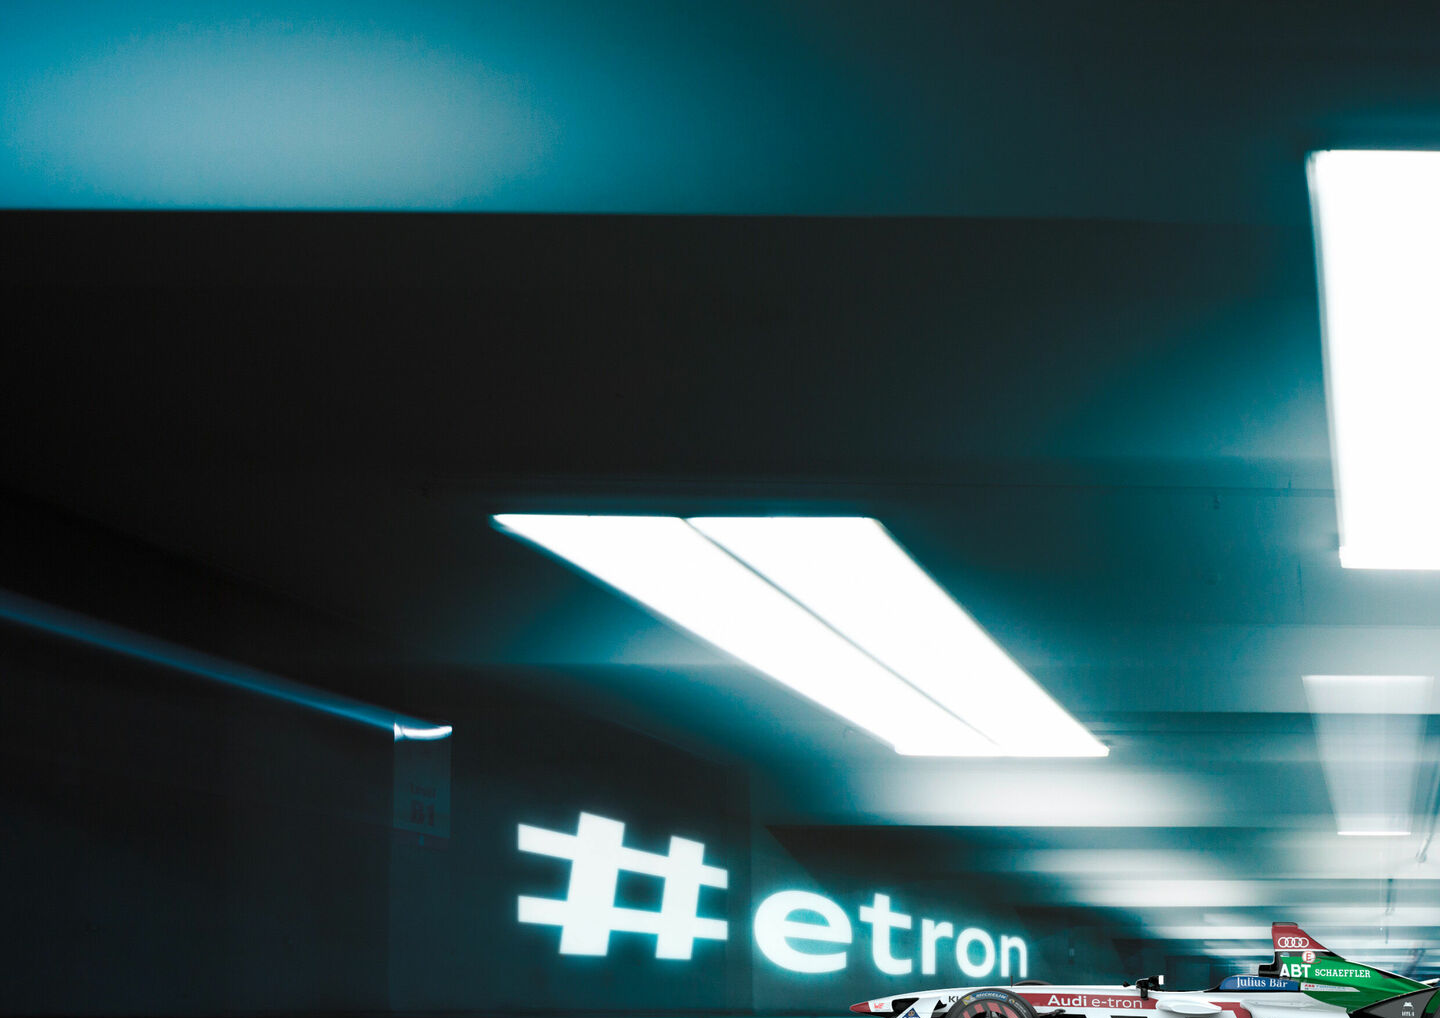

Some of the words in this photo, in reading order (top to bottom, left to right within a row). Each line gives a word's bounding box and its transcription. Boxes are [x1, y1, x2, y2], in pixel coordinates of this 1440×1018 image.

[1280, 964, 1311, 978] ABT
[1315, 969, 1371, 979] SCHAEFFLER
[1237, 977, 1266, 988] Julius
[1269, 979, 1288, 988] Bär
[974, 992, 1008, 1000] MICHELIN
[1047, 995, 1087, 1007] Audi
[1091, 996, 1143, 1009] e-tron
